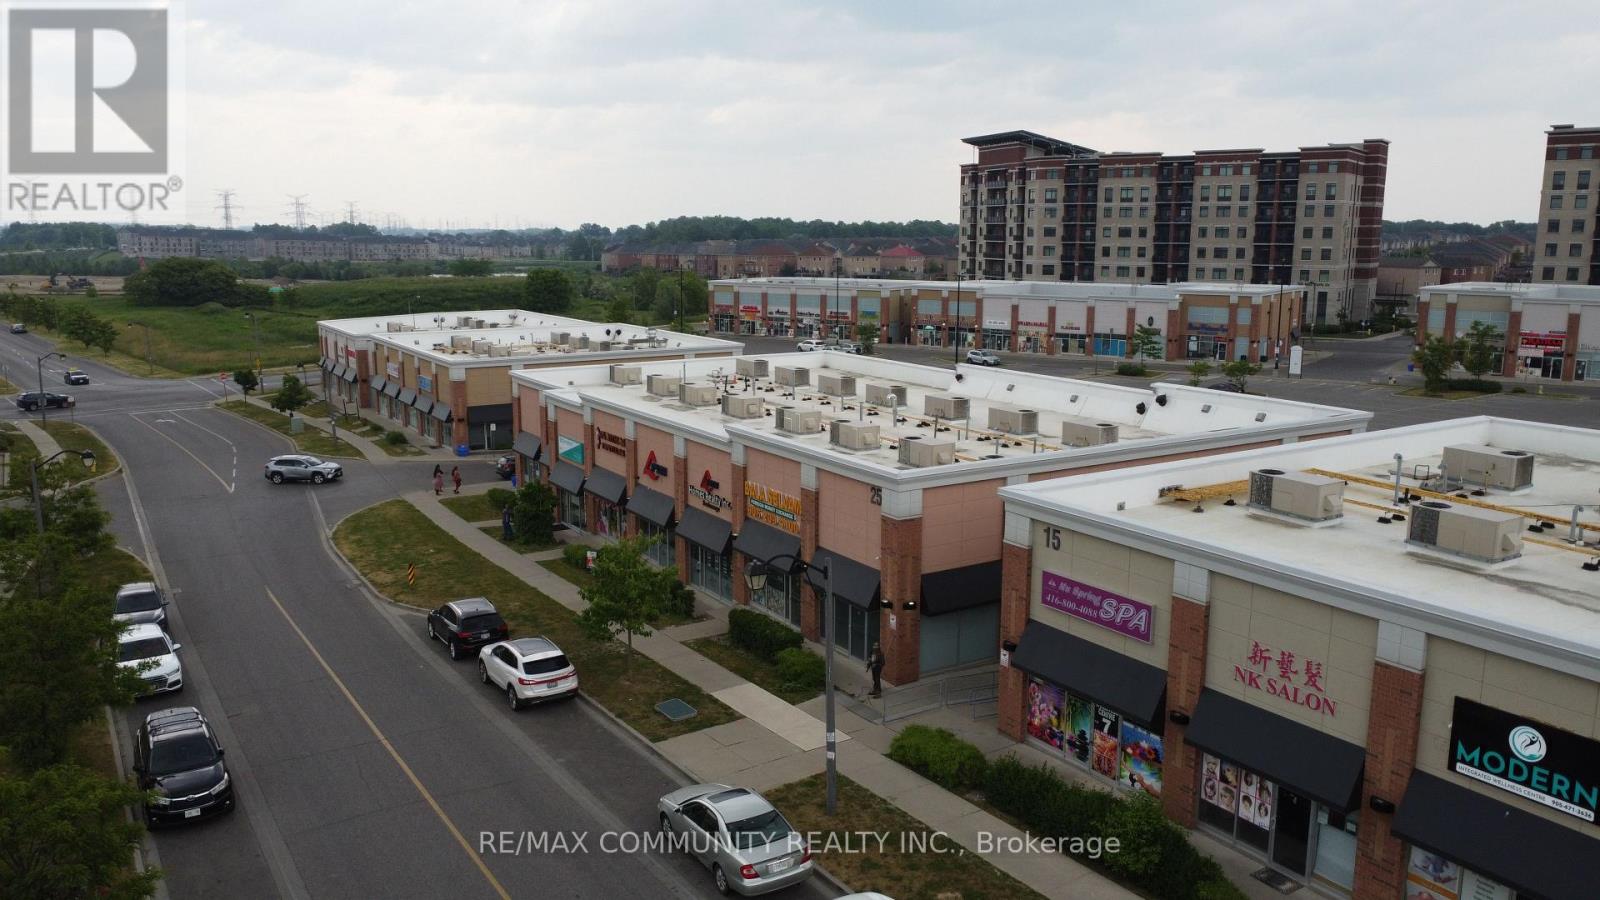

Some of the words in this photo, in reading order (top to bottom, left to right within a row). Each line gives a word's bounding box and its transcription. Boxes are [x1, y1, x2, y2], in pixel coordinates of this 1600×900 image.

[870, 487, 882, 506] 25
[1043, 527, 1061, 551] 15
[1099, 598, 1149, 635] SPA
[1233, 664, 1262, 691] NK
[1266, 677, 1338, 718] SALON
[1102, 718, 1112, 734] 7
[1456, 740, 1599, 810] MODERN
[1458, 765, 1492, 782] INTEGRATED
[1492, 777, 1523, 794] WELLNESS
[1523, 789, 1546, 802] CENTRE
